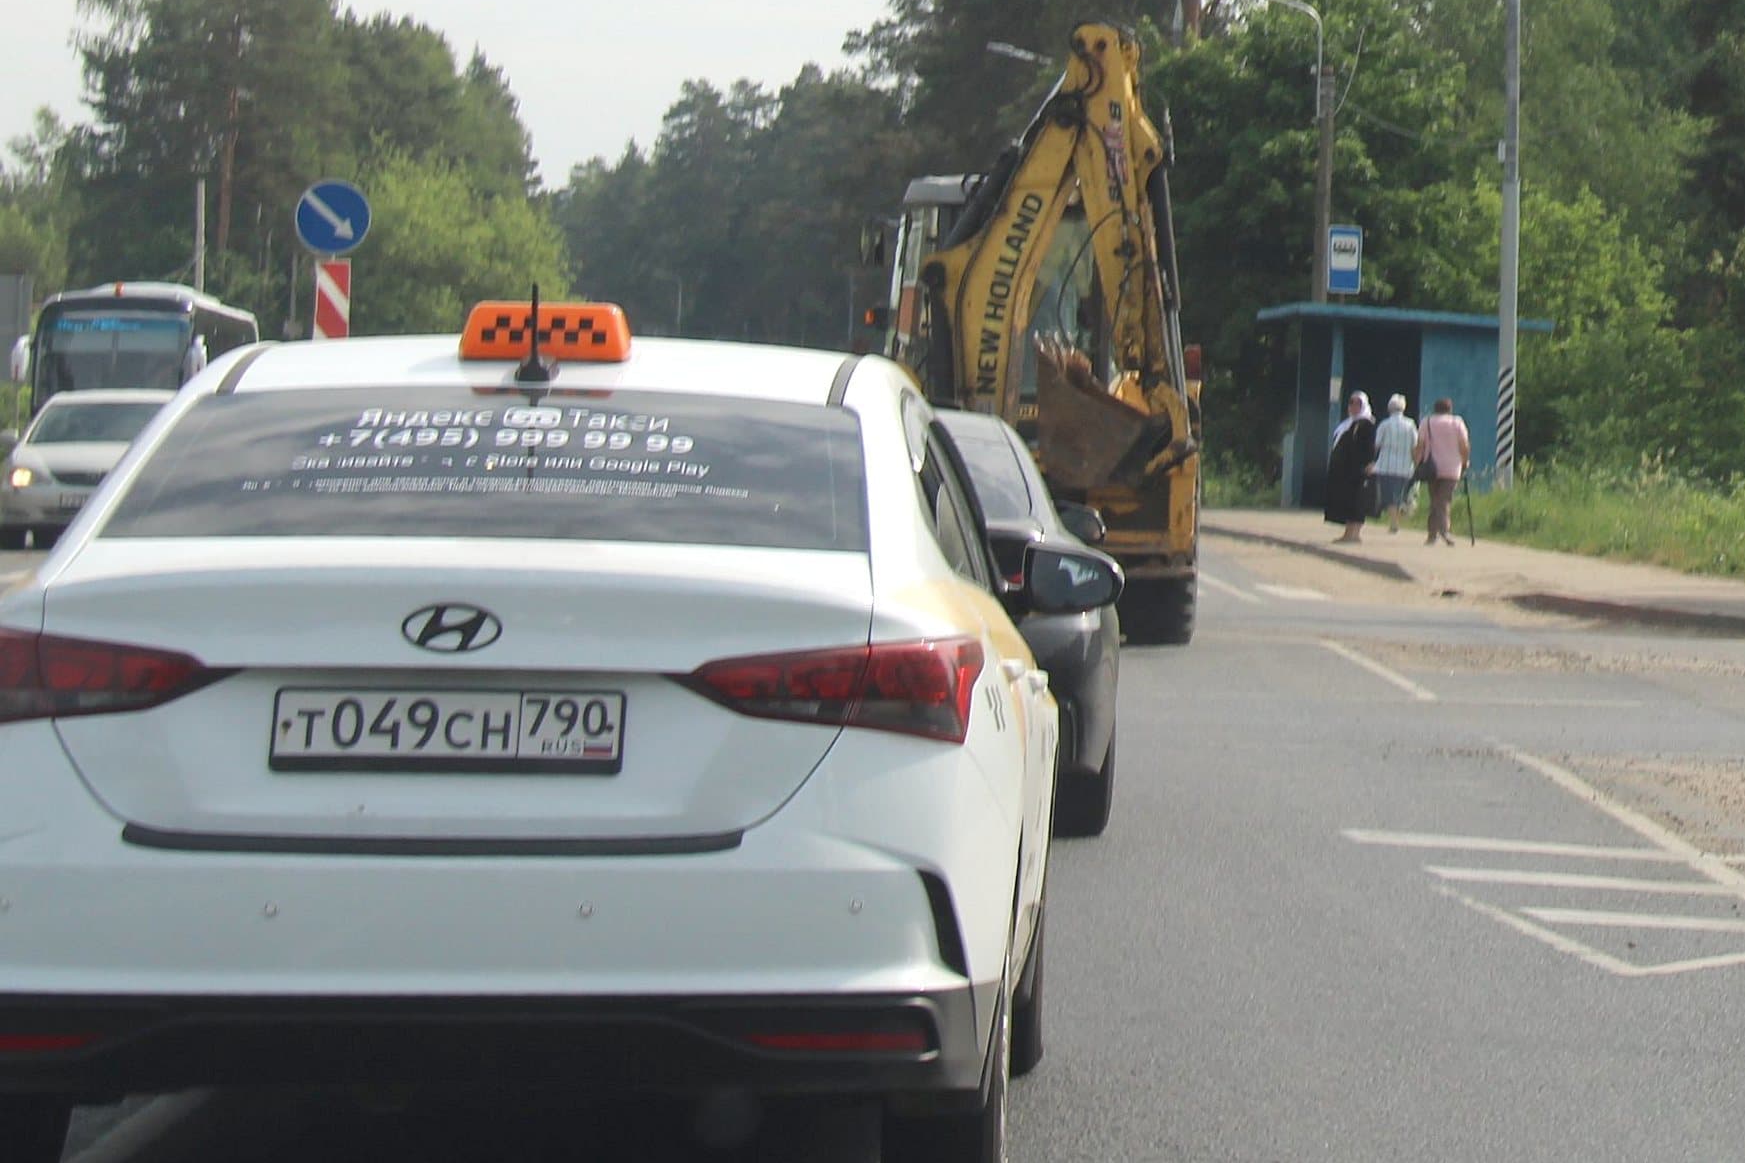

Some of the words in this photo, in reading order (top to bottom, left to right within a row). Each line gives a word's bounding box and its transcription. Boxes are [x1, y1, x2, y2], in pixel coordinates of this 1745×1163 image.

[984, 190, 1044, 321] HOLLAND
[975, 324, 1001, 396] NEW
[495, 428, 570, 447] 999
[583, 430, 633, 450] 99
[646, 433, 695, 454] 99
[588, 455, 661, 475] Google
[666, 459, 711, 480] Play
[525, 698, 608, 738] 790
